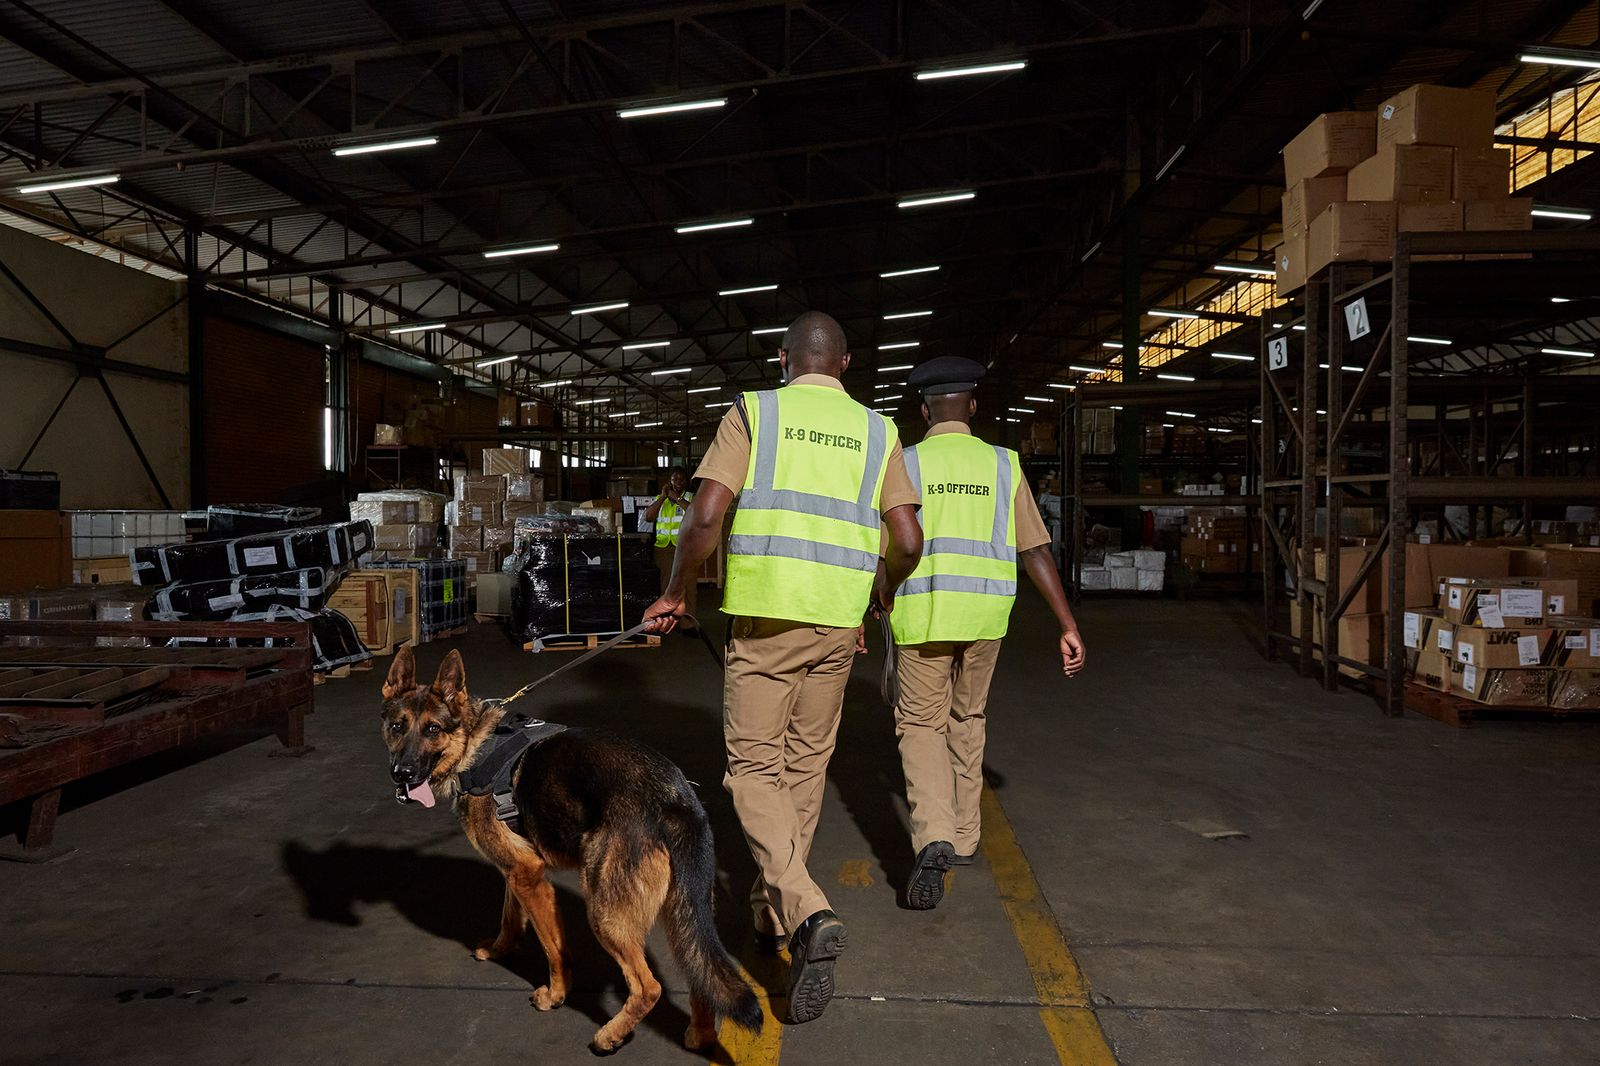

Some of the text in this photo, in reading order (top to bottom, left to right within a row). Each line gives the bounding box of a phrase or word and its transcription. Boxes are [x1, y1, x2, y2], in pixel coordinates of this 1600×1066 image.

[1352, 304, 1365, 335] 2
[1274, 341, 1283, 366] 3
[784, 427, 862, 452] K-9 OFFICER
[927, 482, 990, 497] K-9 OFFICER
